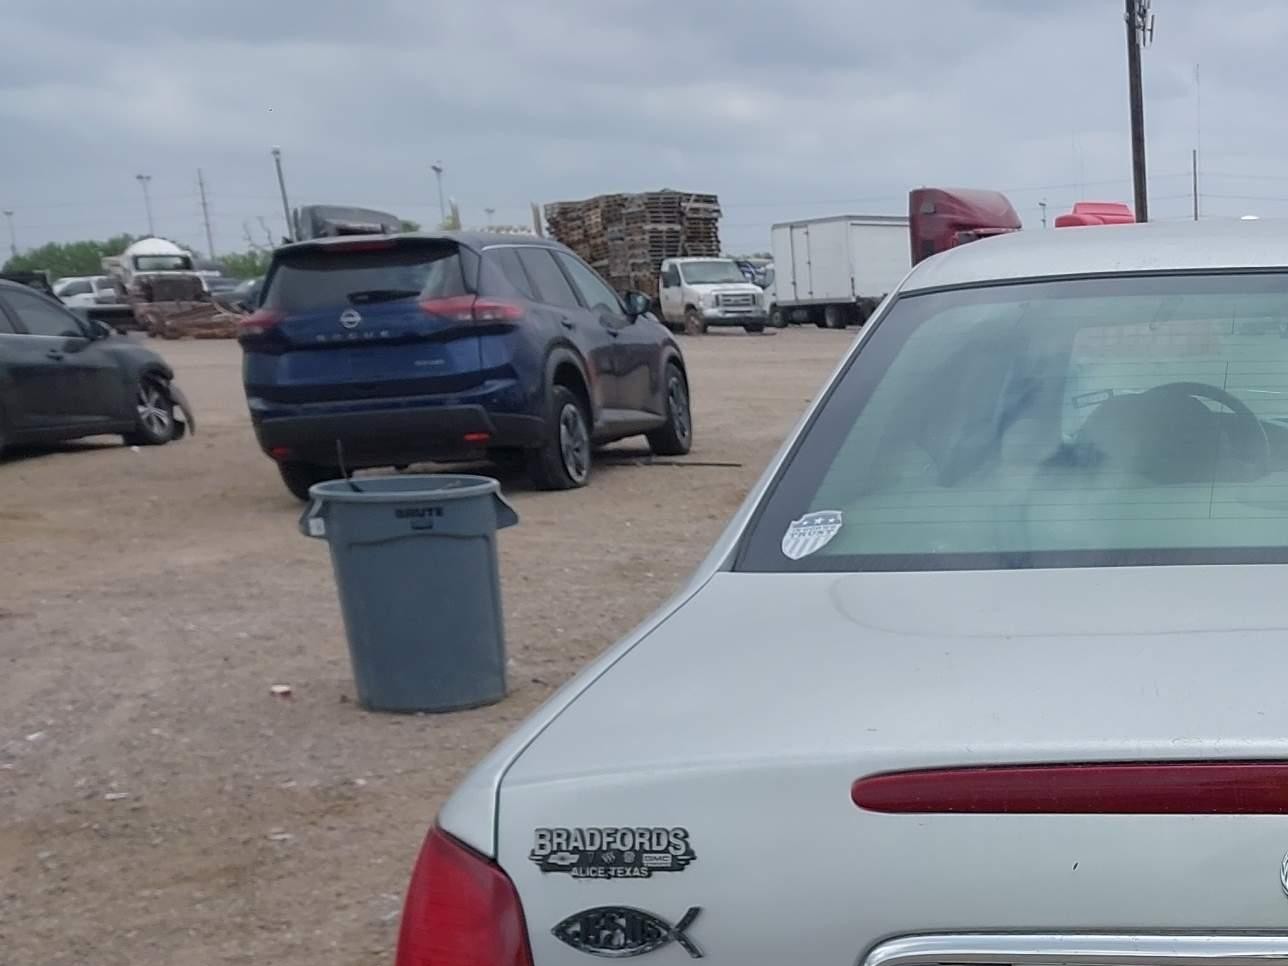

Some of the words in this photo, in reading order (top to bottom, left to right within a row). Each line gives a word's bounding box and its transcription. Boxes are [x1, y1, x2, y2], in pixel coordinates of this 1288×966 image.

[395, 506, 444, 519] BRUTE
[533, 827, 690, 856] BRADFORDS
[610, 866, 650, 877] TEXAS
